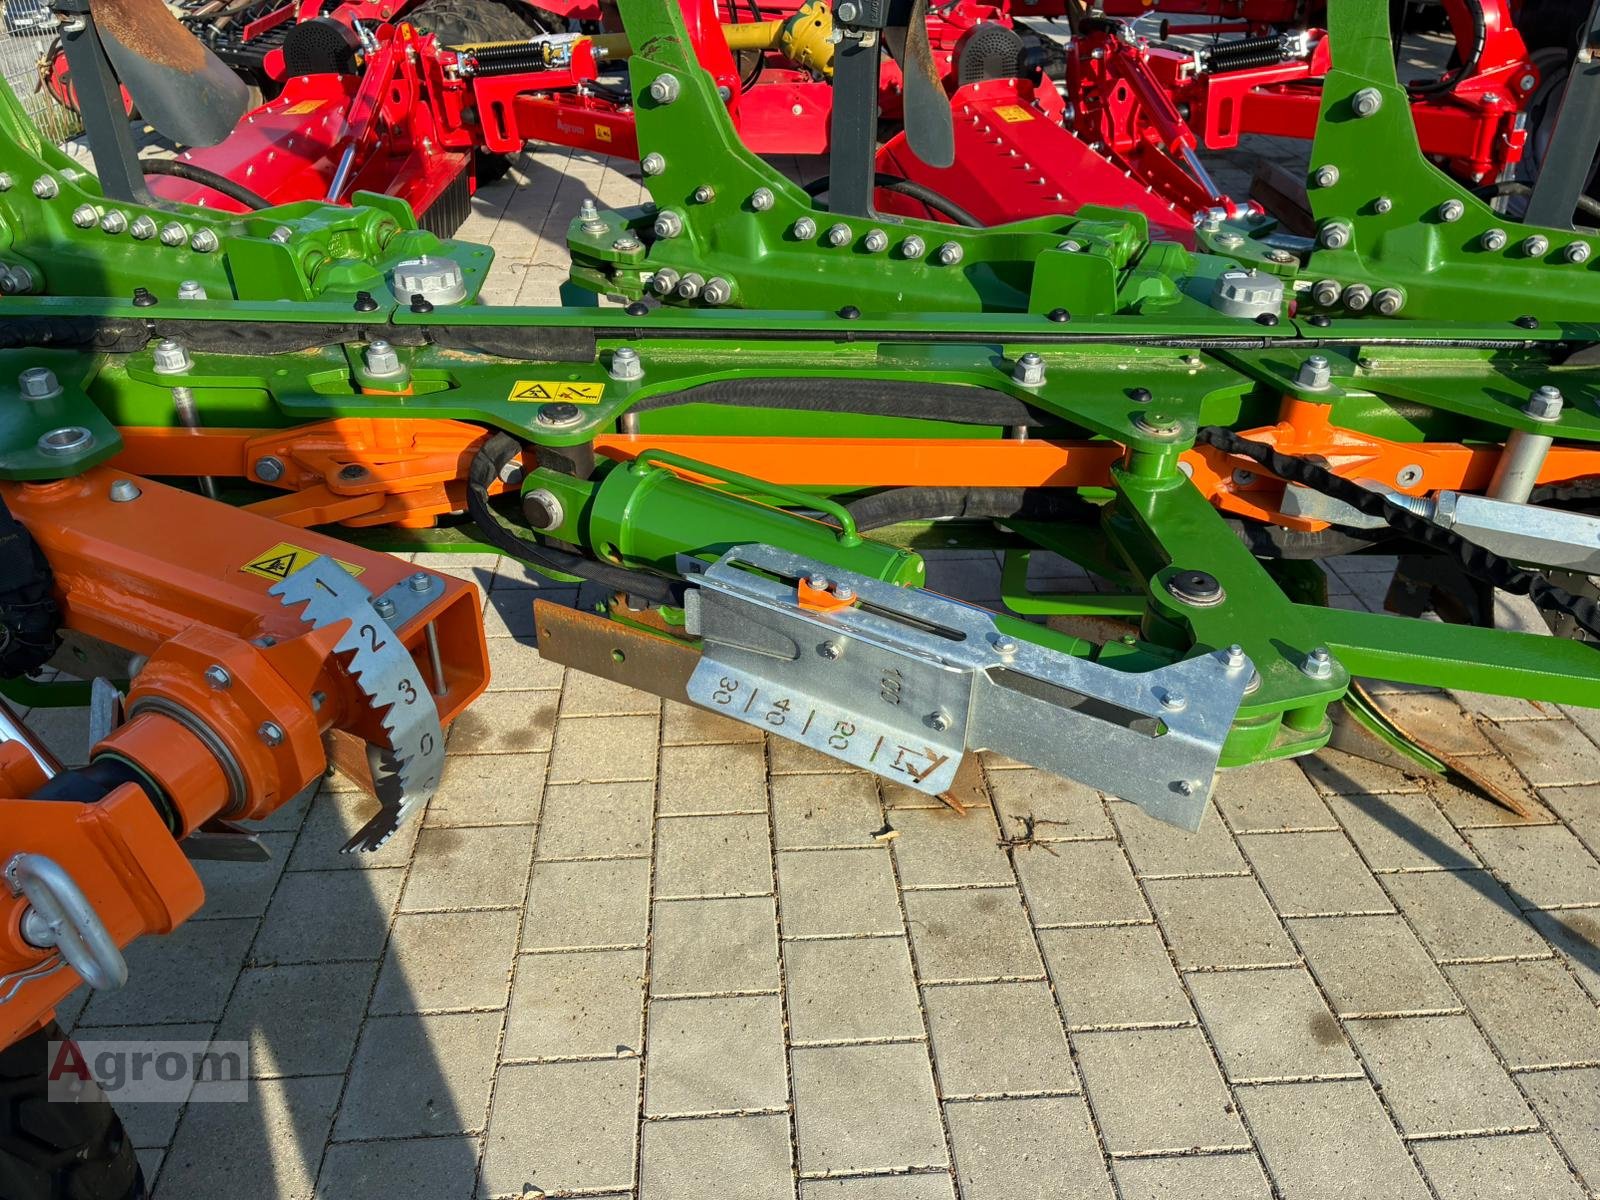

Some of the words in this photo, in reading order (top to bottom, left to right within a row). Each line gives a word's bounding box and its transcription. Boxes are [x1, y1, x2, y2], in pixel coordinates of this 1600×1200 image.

[315, 577, 338, 597] 1
[360, 624, 386, 652] 2
[398, 678, 417, 705] 3
[712, 676, 739, 705] 30
[765, 698, 791, 726] 40
[828, 720, 856, 751] 50
